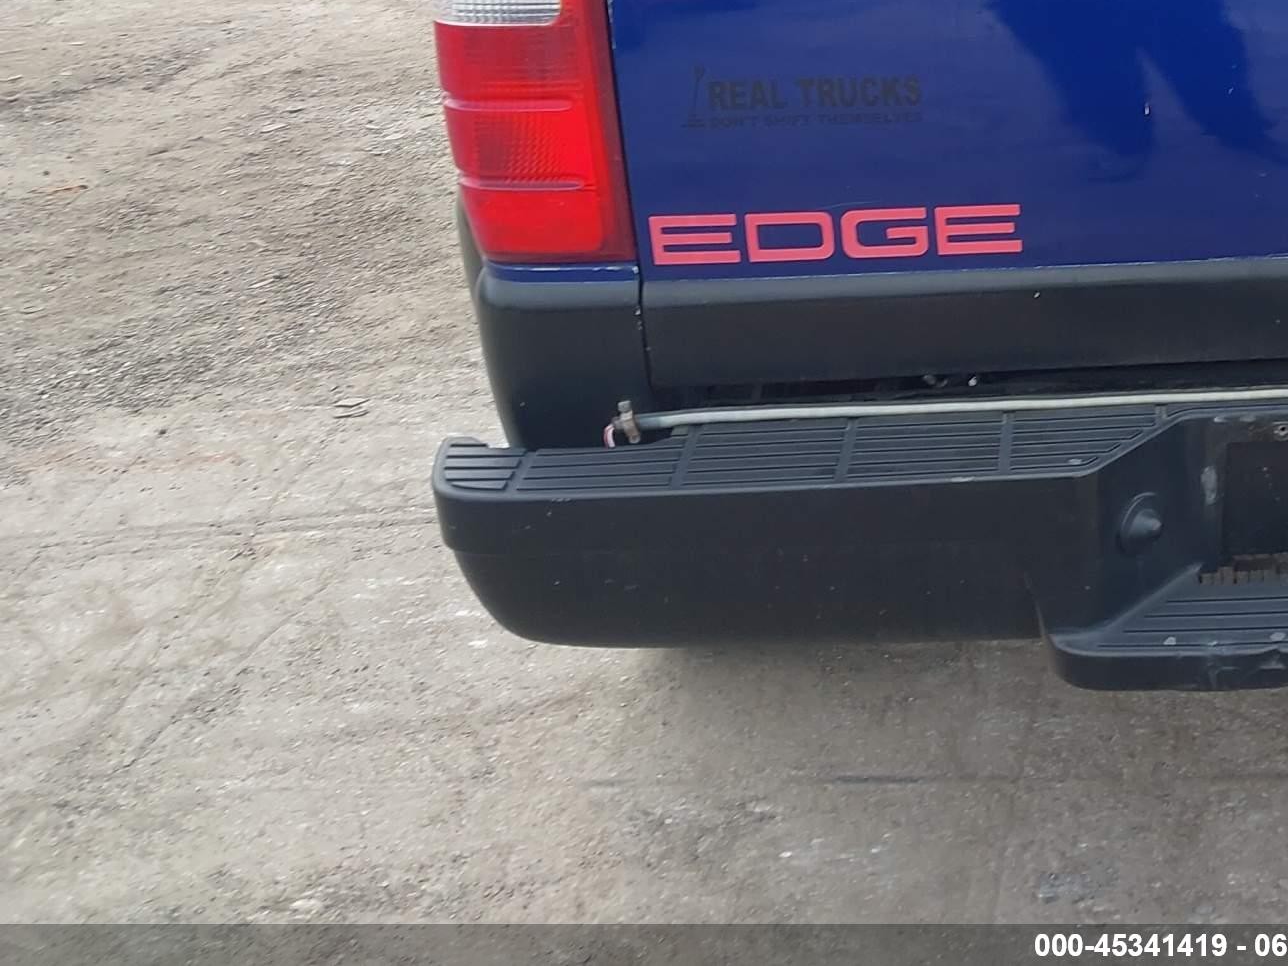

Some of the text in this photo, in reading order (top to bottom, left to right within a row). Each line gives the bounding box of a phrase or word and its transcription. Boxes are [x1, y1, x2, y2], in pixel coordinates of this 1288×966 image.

[708, 74, 922, 110] REAL TRUCKS
[648, 204, 1023, 265] EDGE
